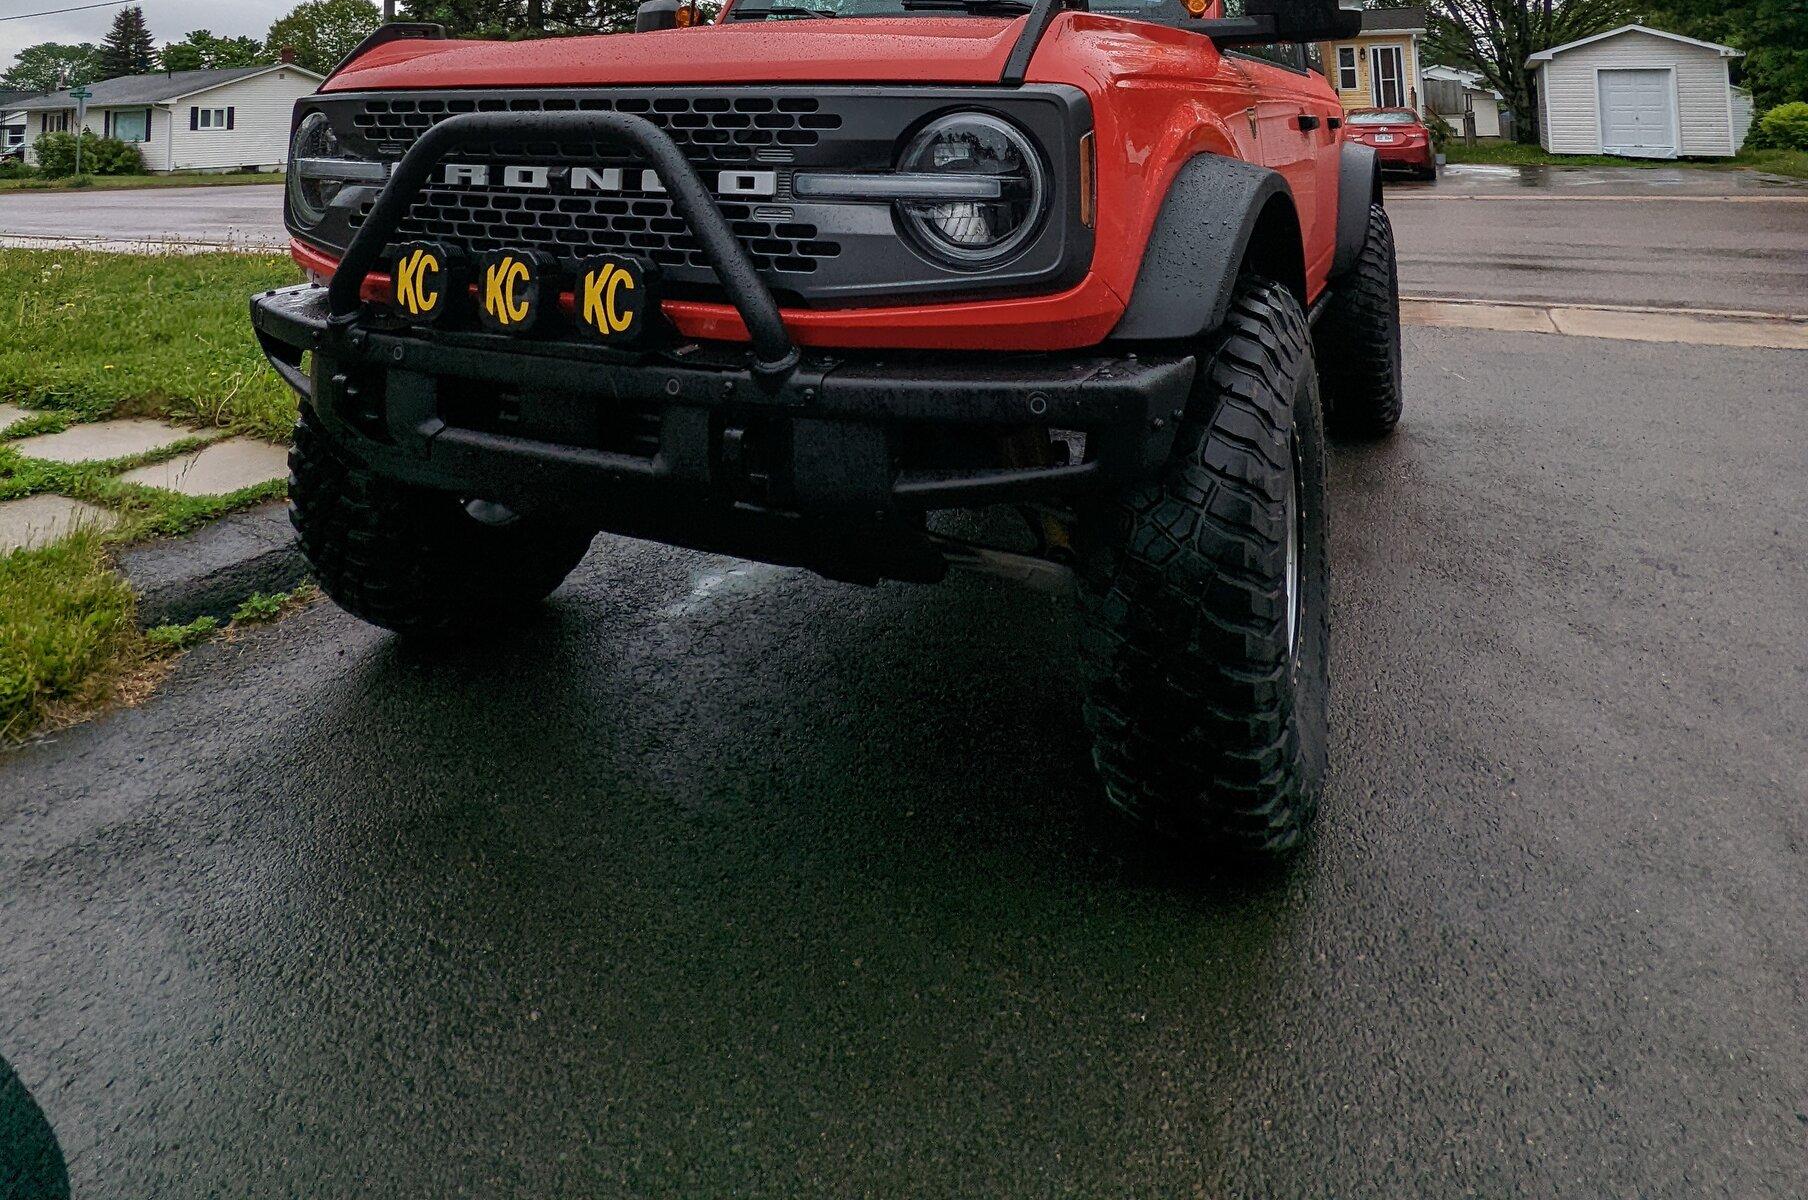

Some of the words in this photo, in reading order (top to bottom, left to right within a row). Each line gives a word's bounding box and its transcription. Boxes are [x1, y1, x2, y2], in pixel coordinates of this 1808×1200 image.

[391, 161, 777, 196] RONO
[397, 249, 439, 315] KC
[485, 256, 530, 325] KC
[583, 263, 635, 335] KC
